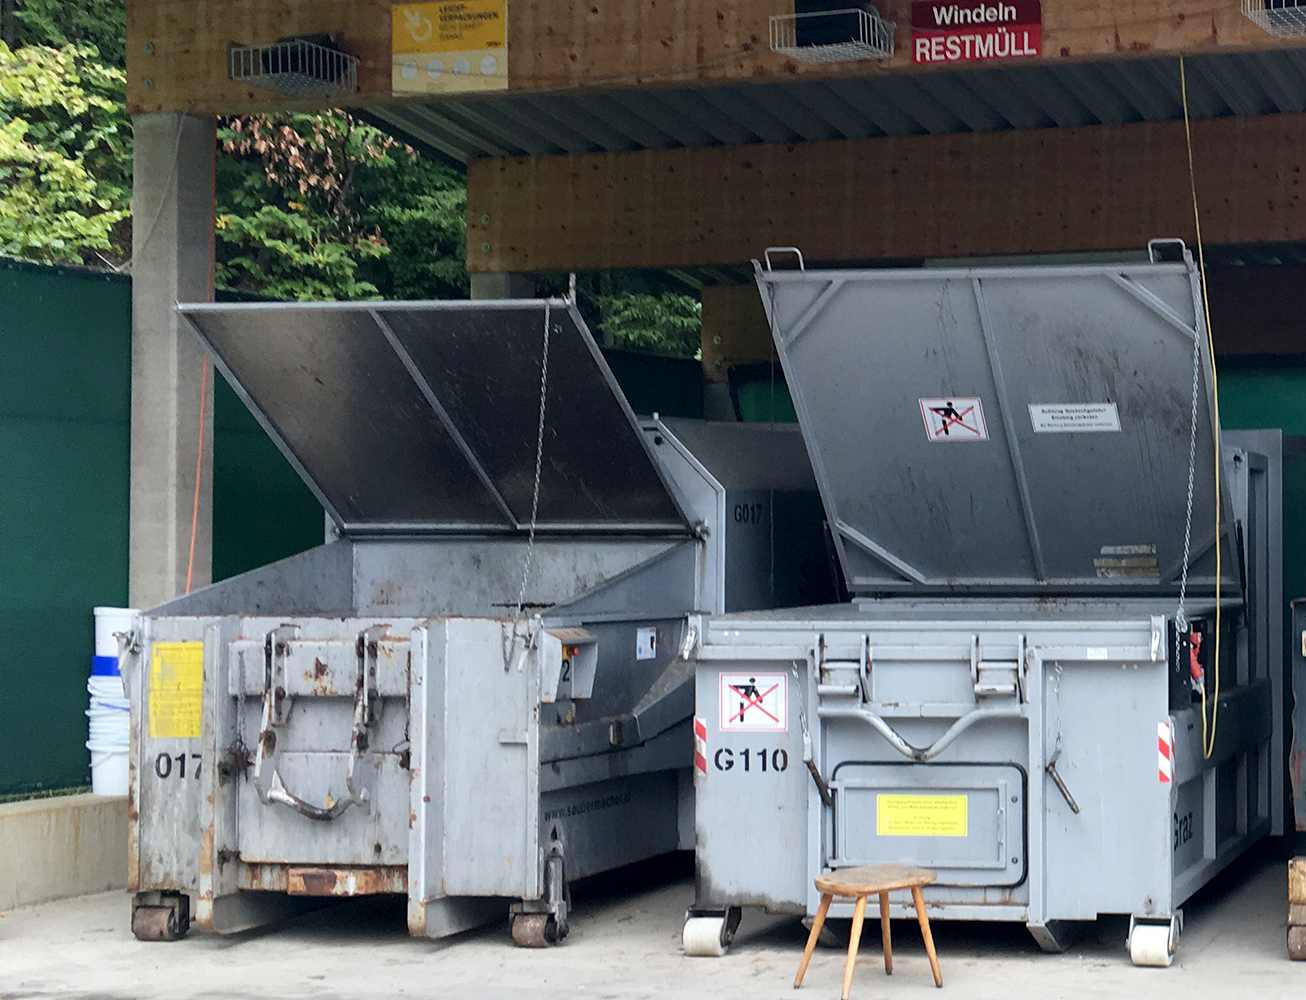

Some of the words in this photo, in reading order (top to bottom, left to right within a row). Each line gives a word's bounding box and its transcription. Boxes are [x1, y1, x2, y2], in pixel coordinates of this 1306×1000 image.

[932, 2, 1017, 25] Windeln
[915, 27, 1037, 62] RESTMÜLL
[734, 503, 763, 525] G017
[562, 660, 570, 682] 2
[155, 752, 203, 779] 017
[714, 748, 788, 772] G110
